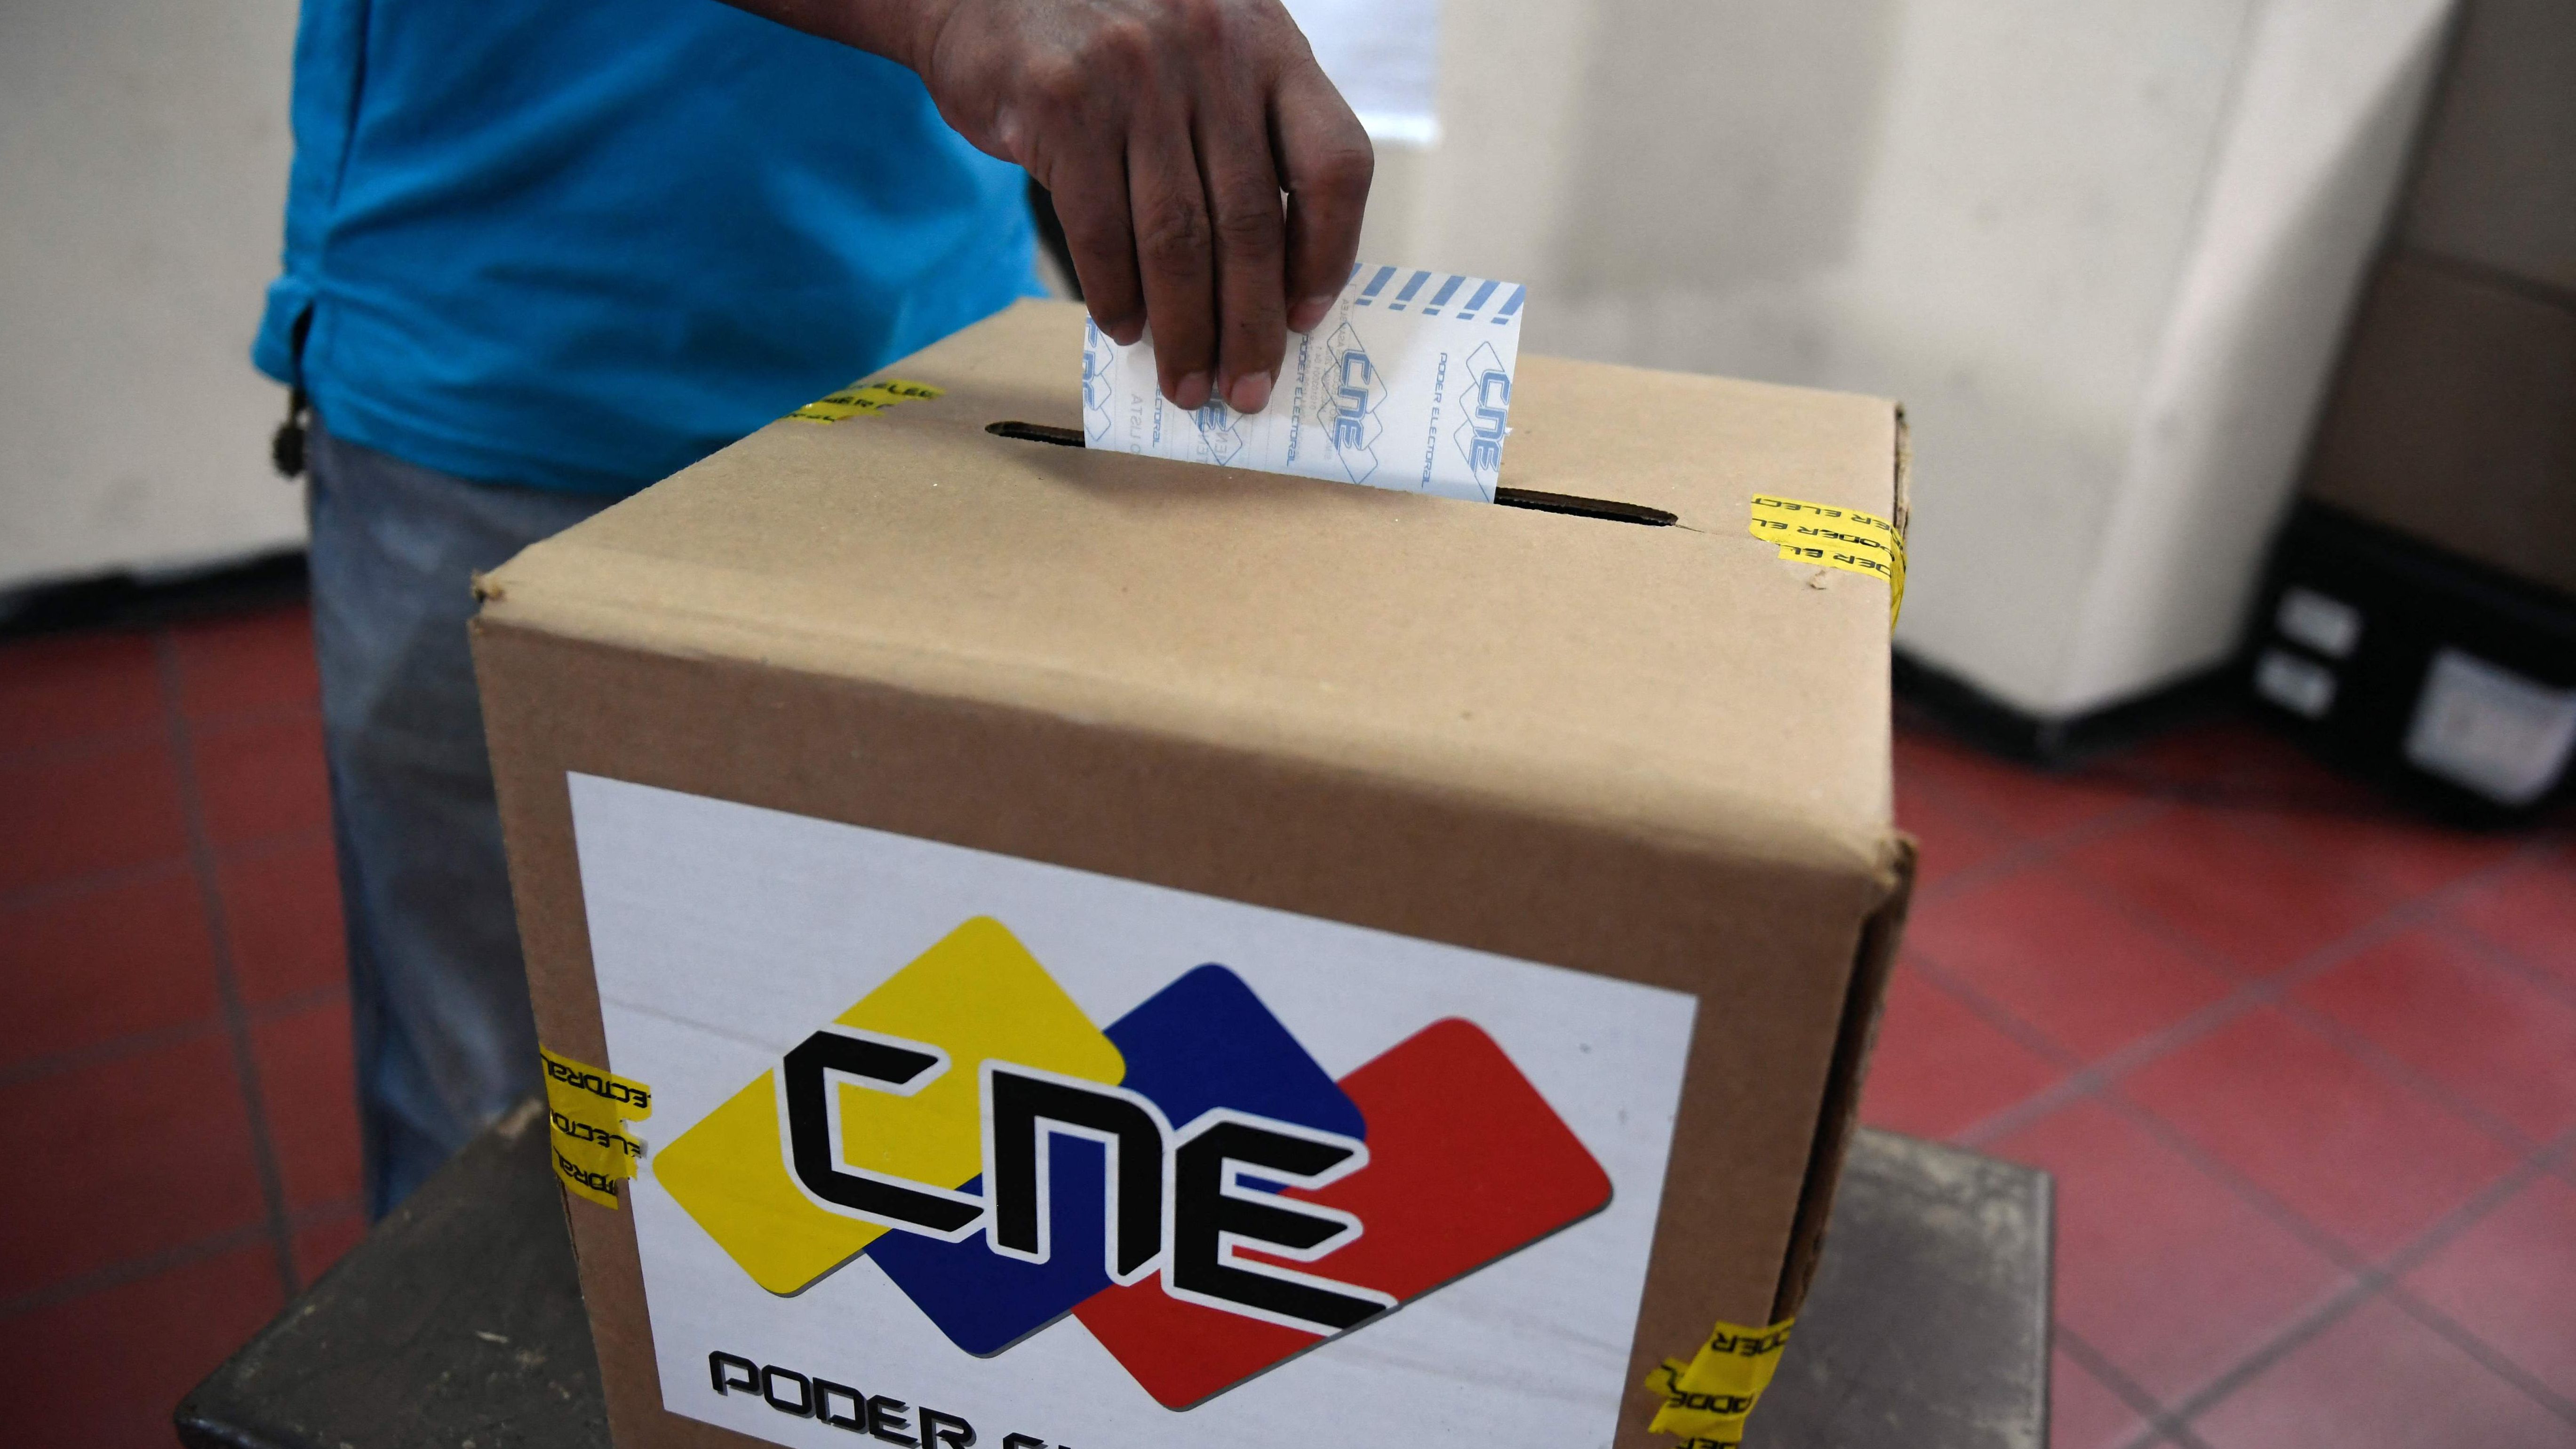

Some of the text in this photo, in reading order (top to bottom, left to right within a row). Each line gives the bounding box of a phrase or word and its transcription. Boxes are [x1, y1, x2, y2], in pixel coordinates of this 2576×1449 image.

[1434, 352, 1447, 403] PODER
[1153, 381, 1162, 448] ECTORAL
[540, 1053, 651, 1108] ECTORAL
[709, 1350, 976, 1449] PODER
